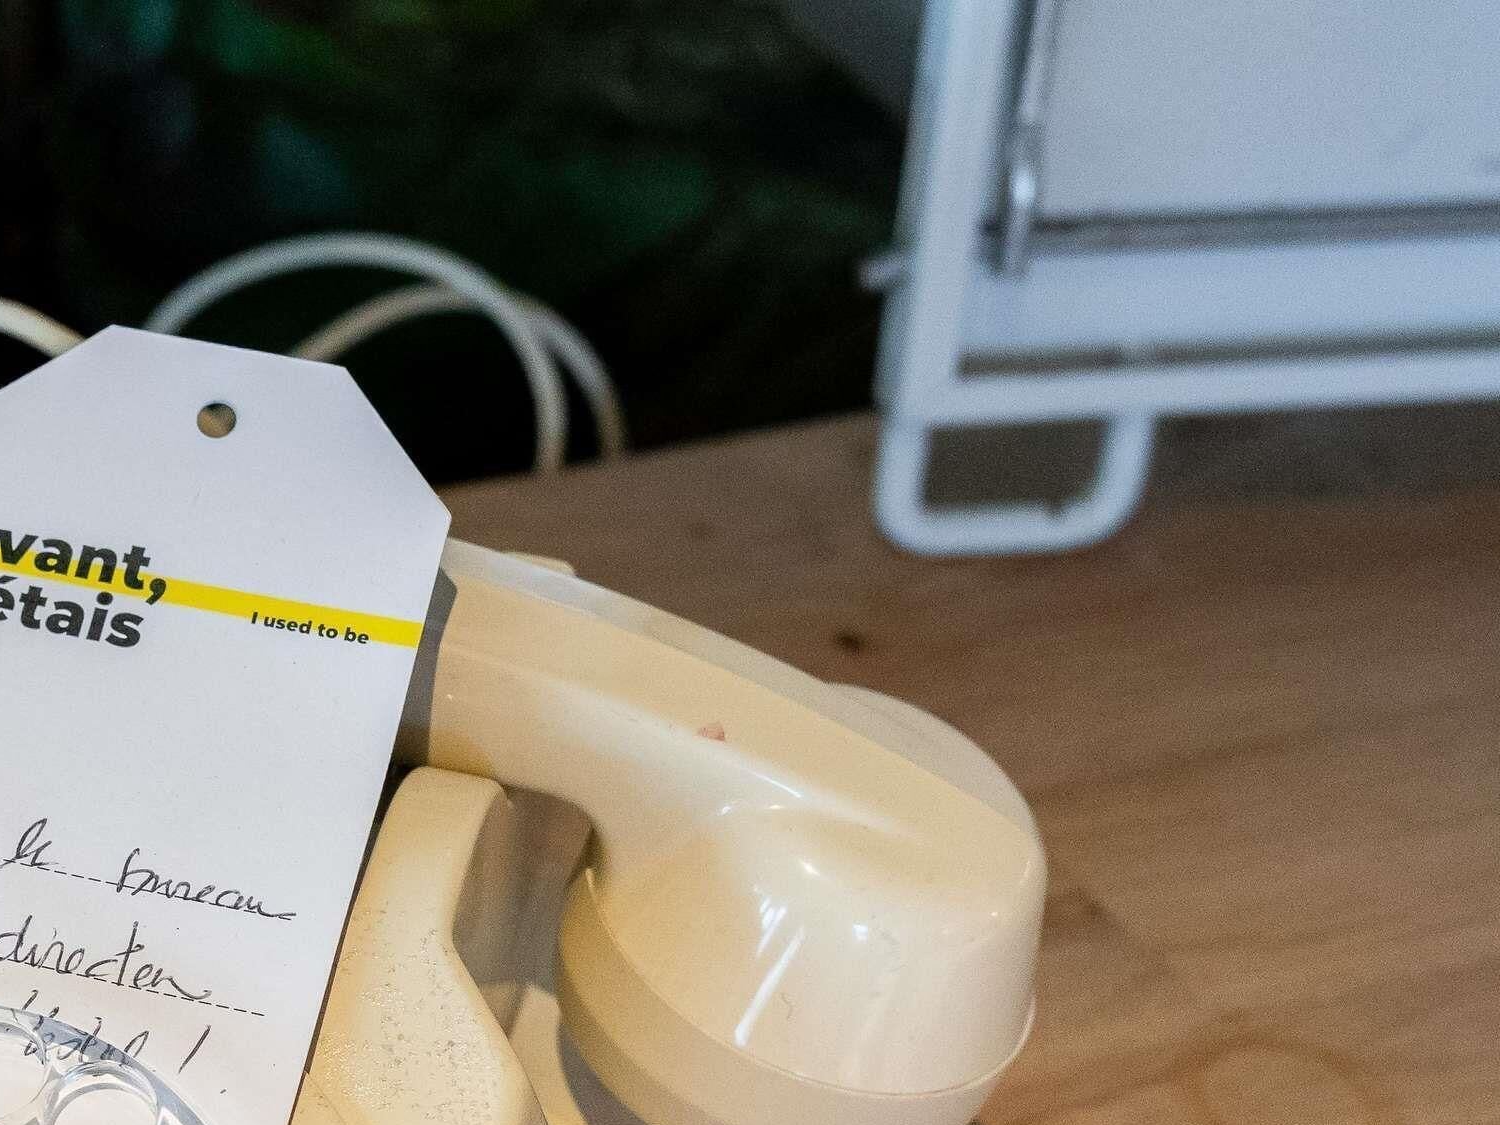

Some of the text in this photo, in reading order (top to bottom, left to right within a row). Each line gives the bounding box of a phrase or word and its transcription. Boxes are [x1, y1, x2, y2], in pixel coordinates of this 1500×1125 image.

[251, 611, 370, 644] I used to be
